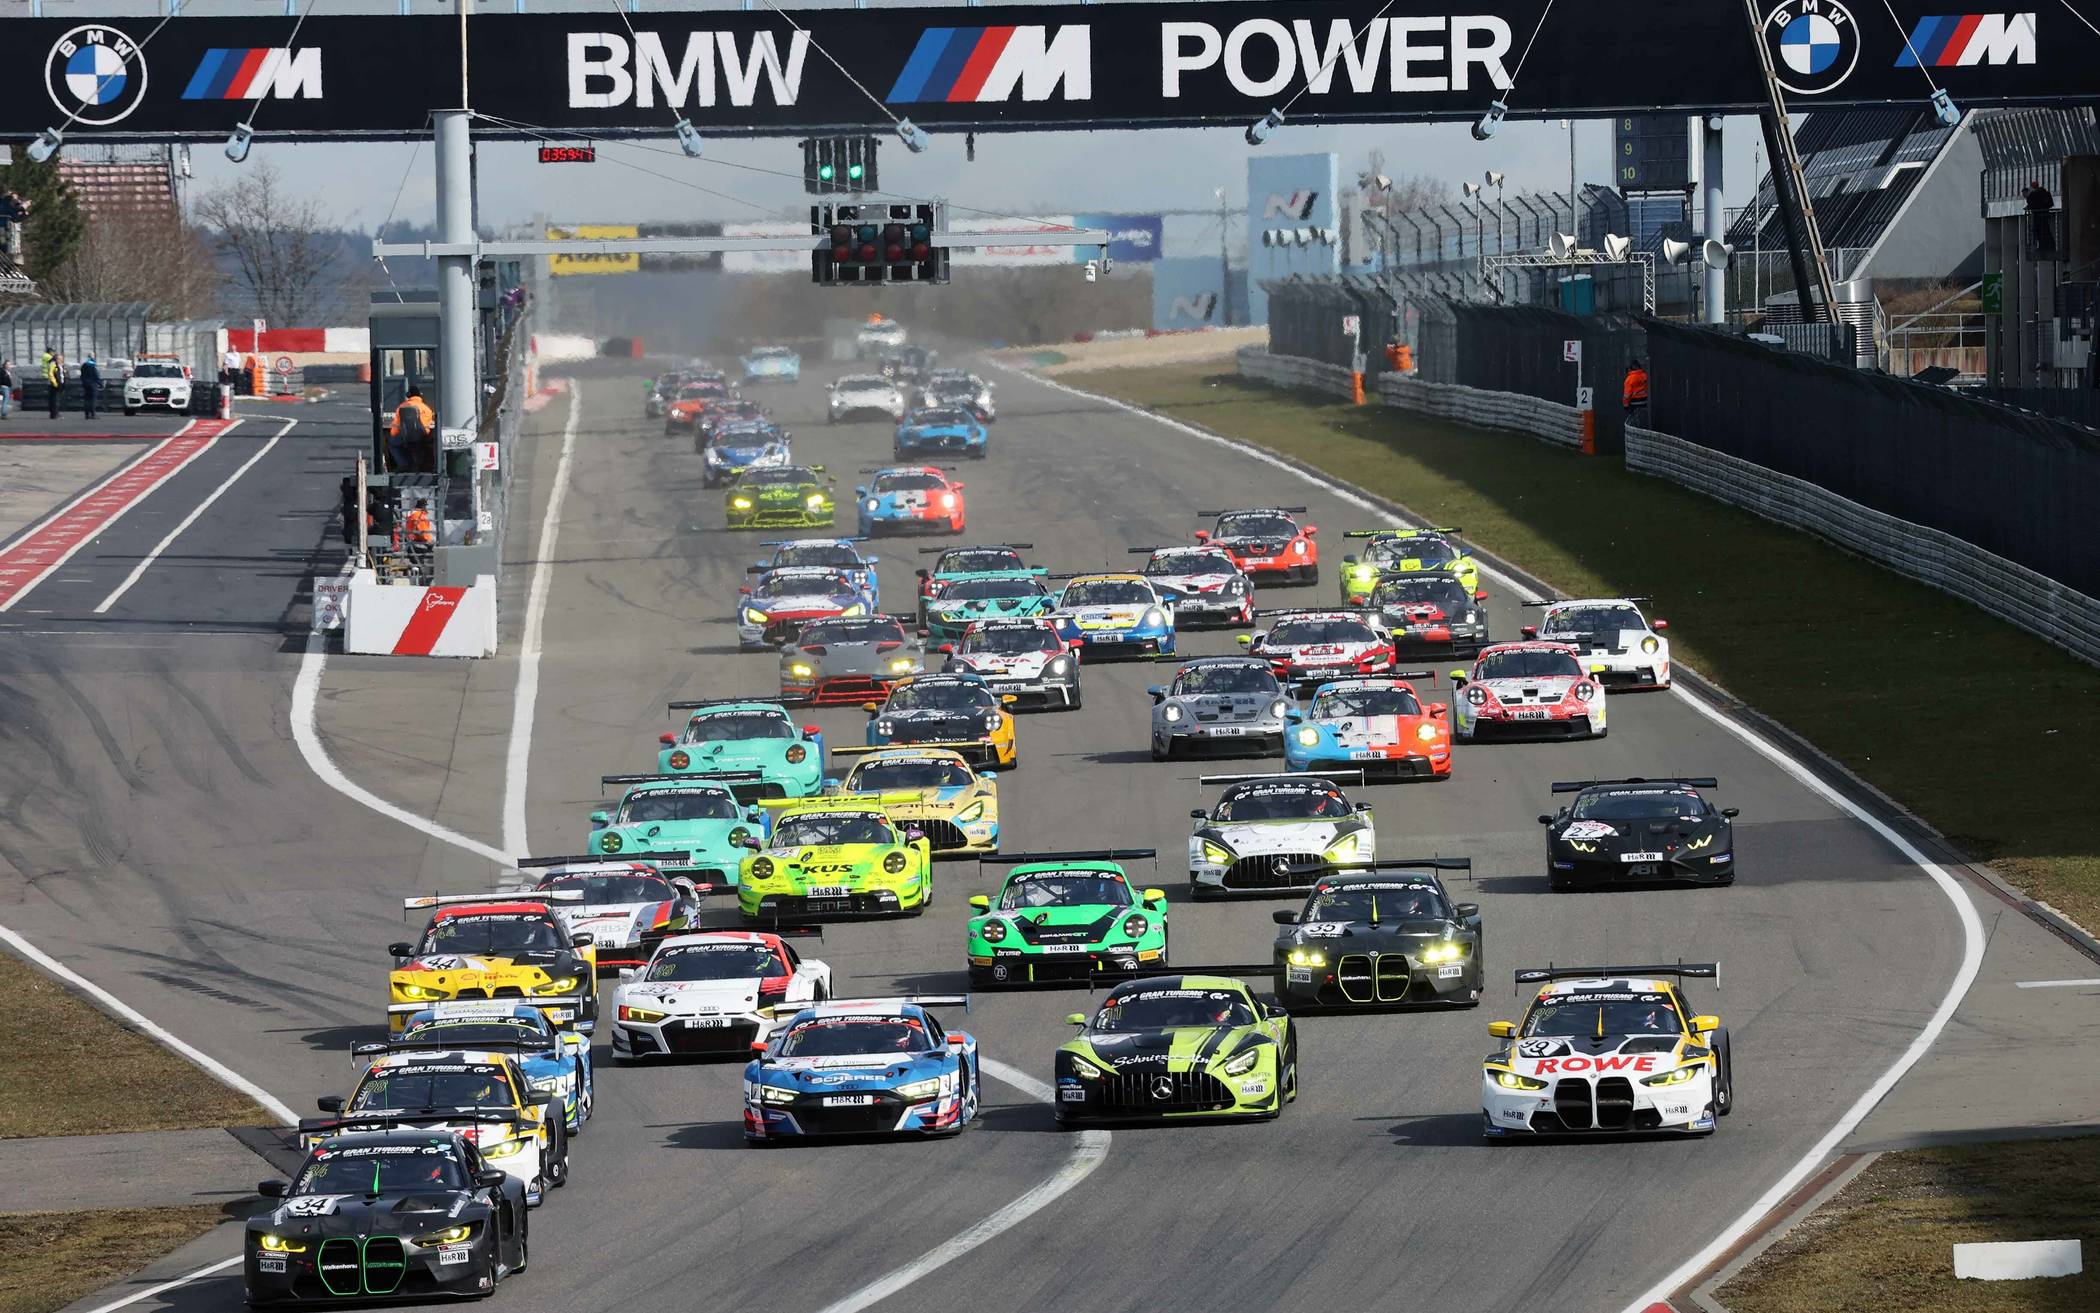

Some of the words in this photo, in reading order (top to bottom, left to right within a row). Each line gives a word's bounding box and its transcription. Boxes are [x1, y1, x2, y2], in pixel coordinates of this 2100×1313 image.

[1774, 1, 1847, 28] BMW
[59, 30, 133, 58] BMW
[1161, 15, 1515, 98] POWER
[568, 30, 811, 108] BMW
[1624, 118, 1632, 131] 8
[1624, 142, 1633, 156] 9
[1621, 166, 1636, 180] 10
[1581, 390, 1588, 404] 2
[989, 657, 1031, 665] AVIA
[1518, 711, 1535, 719] H&R
[1627, 853, 1645, 861] H&R
[802, 863, 854, 876] KÜS
[812, 887, 832, 896] H&R
[1310, 923, 1336, 934] 35
[997, 949, 1021, 957] brose
[1566, 994, 1592, 1002] GRAN
[1594, 993, 1634, 1001] TURISMO
[844, 1015, 883, 1023] TURISMO
[692, 1020, 710, 1029] H&R
[1534, 1056, 1657, 1075] ROWE
[811, 1075, 886, 1084] SCHERER
[832, 1096, 852, 1105] H&R
[342, 1148, 370, 1156] GRAN
[372, 1146, 418, 1154] TURISMO
[296, 1198, 327, 1211] 34
[441, 1253, 457, 1262] H&R
